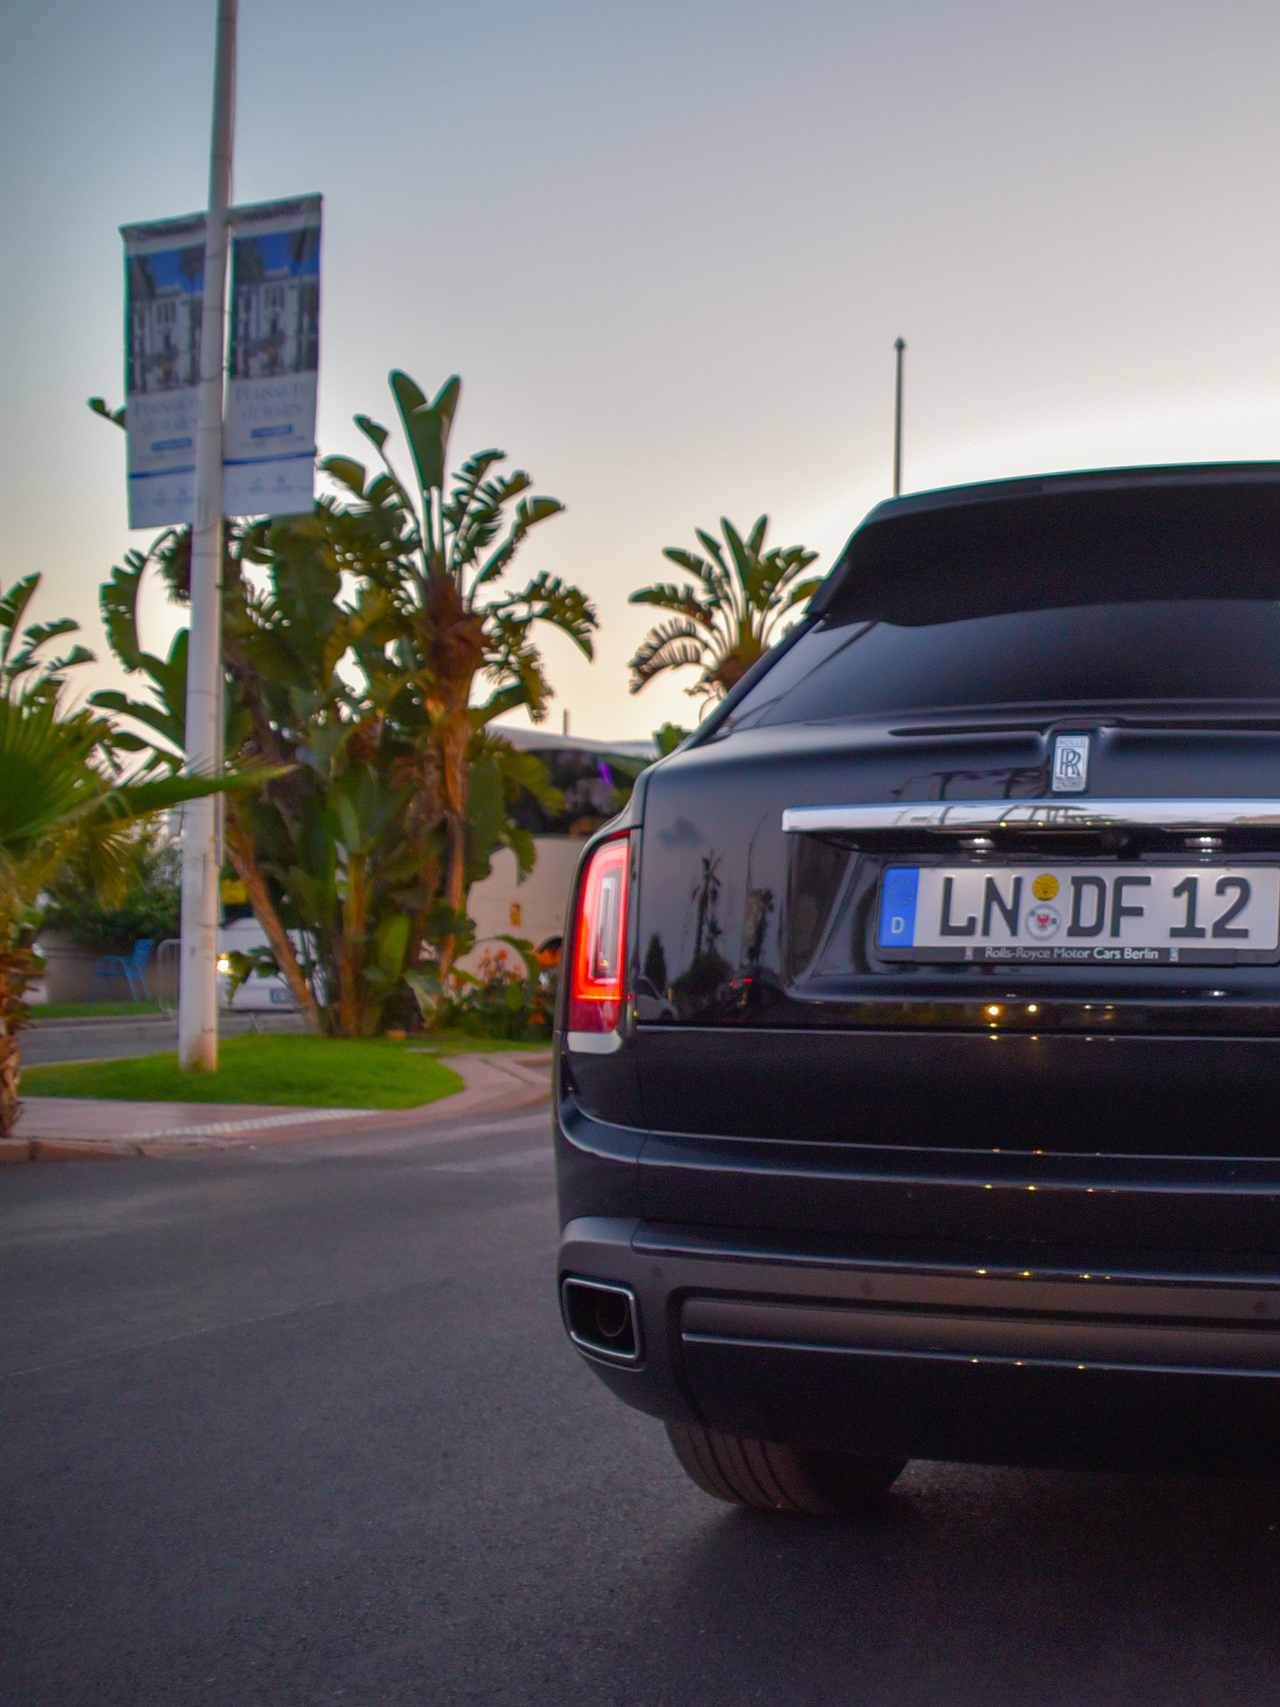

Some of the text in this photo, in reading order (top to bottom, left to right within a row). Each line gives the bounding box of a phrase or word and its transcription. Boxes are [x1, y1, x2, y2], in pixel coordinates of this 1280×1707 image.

[939, 875, 1252, 939] LN DF 12
[891, 916, 905, 934] D
[985, 947, 1050, 960] Rolls-Royce
[1053, 947, 1090, 959] Motor
[1093, 948, 1121, 959] Cars
[1124, 947, 1159, 960] Berlin
